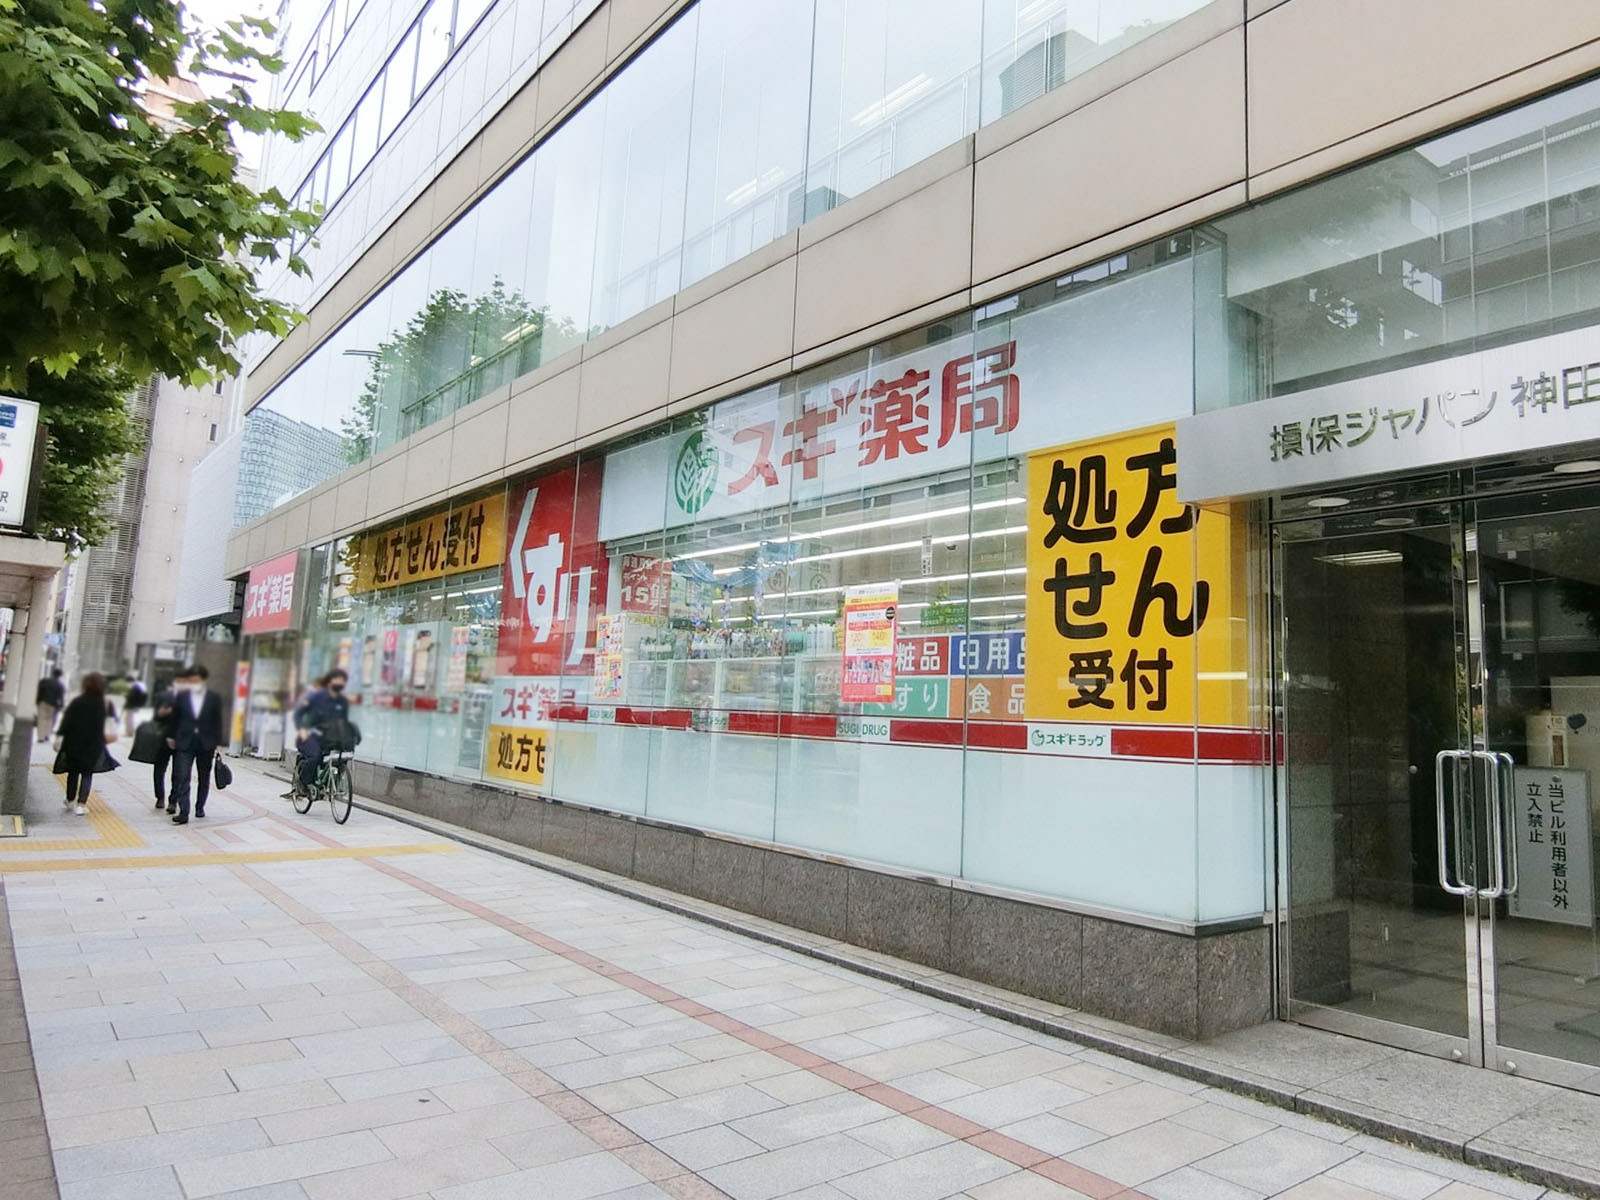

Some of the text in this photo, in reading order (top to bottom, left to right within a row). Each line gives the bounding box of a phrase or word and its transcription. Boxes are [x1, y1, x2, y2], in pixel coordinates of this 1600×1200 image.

[727, 341, 1020, 496] スギ薬局
[1043, 438, 1200, 549] 処方
[373, 504, 485, 584] 処方せん受付
[510, 487, 592, 666] くすり
[247, 572, 294, 618] スギ薬局
[1043, 546, 1209, 638] せん
[877, 683, 939, 712] すり
[1067, 648, 1174, 711] 受付
[838, 723, 888, 737] SUGI DRUG
[1046, 733, 1107, 747] スギドラッグ
[1526, 782, 1544, 844] 立入禁止
[1549, 783, 1569, 910] 当ビル利用者以外
